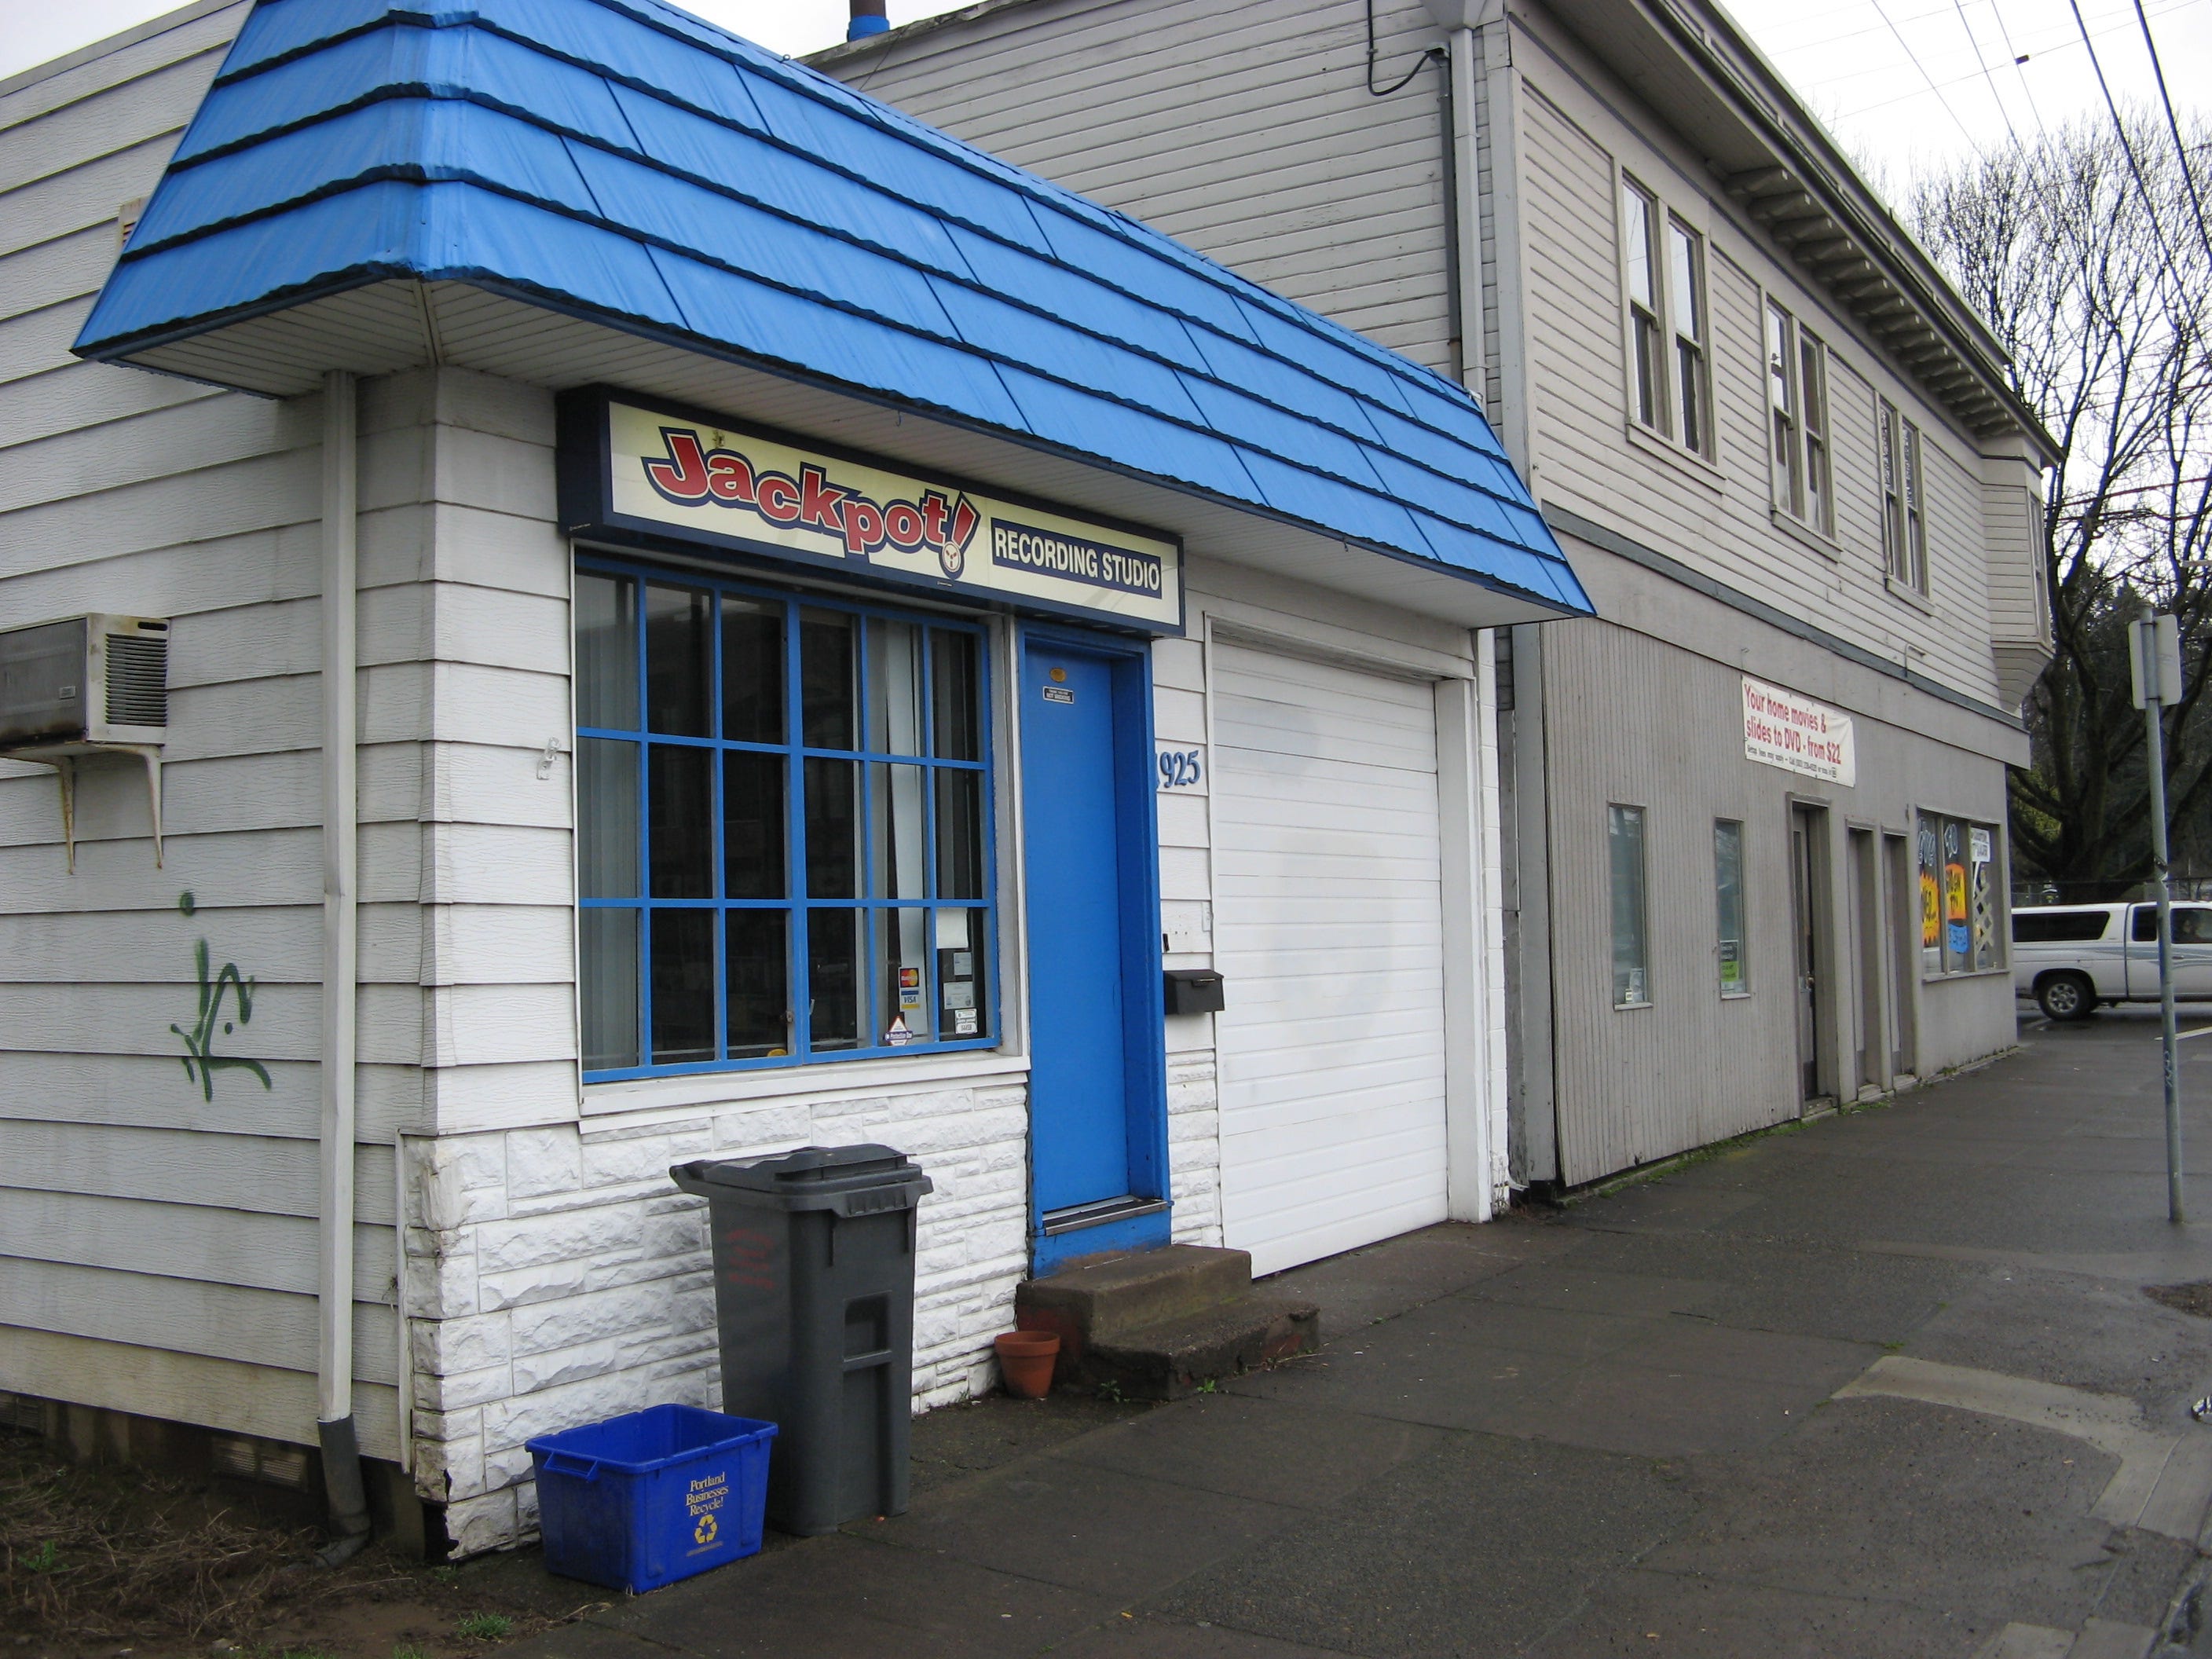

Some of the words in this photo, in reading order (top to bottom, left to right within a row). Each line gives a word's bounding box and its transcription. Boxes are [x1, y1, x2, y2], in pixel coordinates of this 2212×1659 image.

[644, 430, 979, 576] Jackpot!
[994, 526, 1098, 579] RECORDING
[1101, 551, 1160, 591] STUDIO
[1744, 683, 1765, 712] Your
[1767, 693, 1789, 722] home
[1791, 707, 1818, 731] movies
[1820, 713, 1826, 734] &
[1746, 716, 1771, 744] slides
[1774, 725, 1782, 747] to
[1784, 727, 1801, 753] DVD
[1807, 735, 1825, 760] from
[903, 995, 917, 1004] VISA
[690, 1471, 725, 1492] Portland
[690, 1496, 724, 1516] Recycle!
